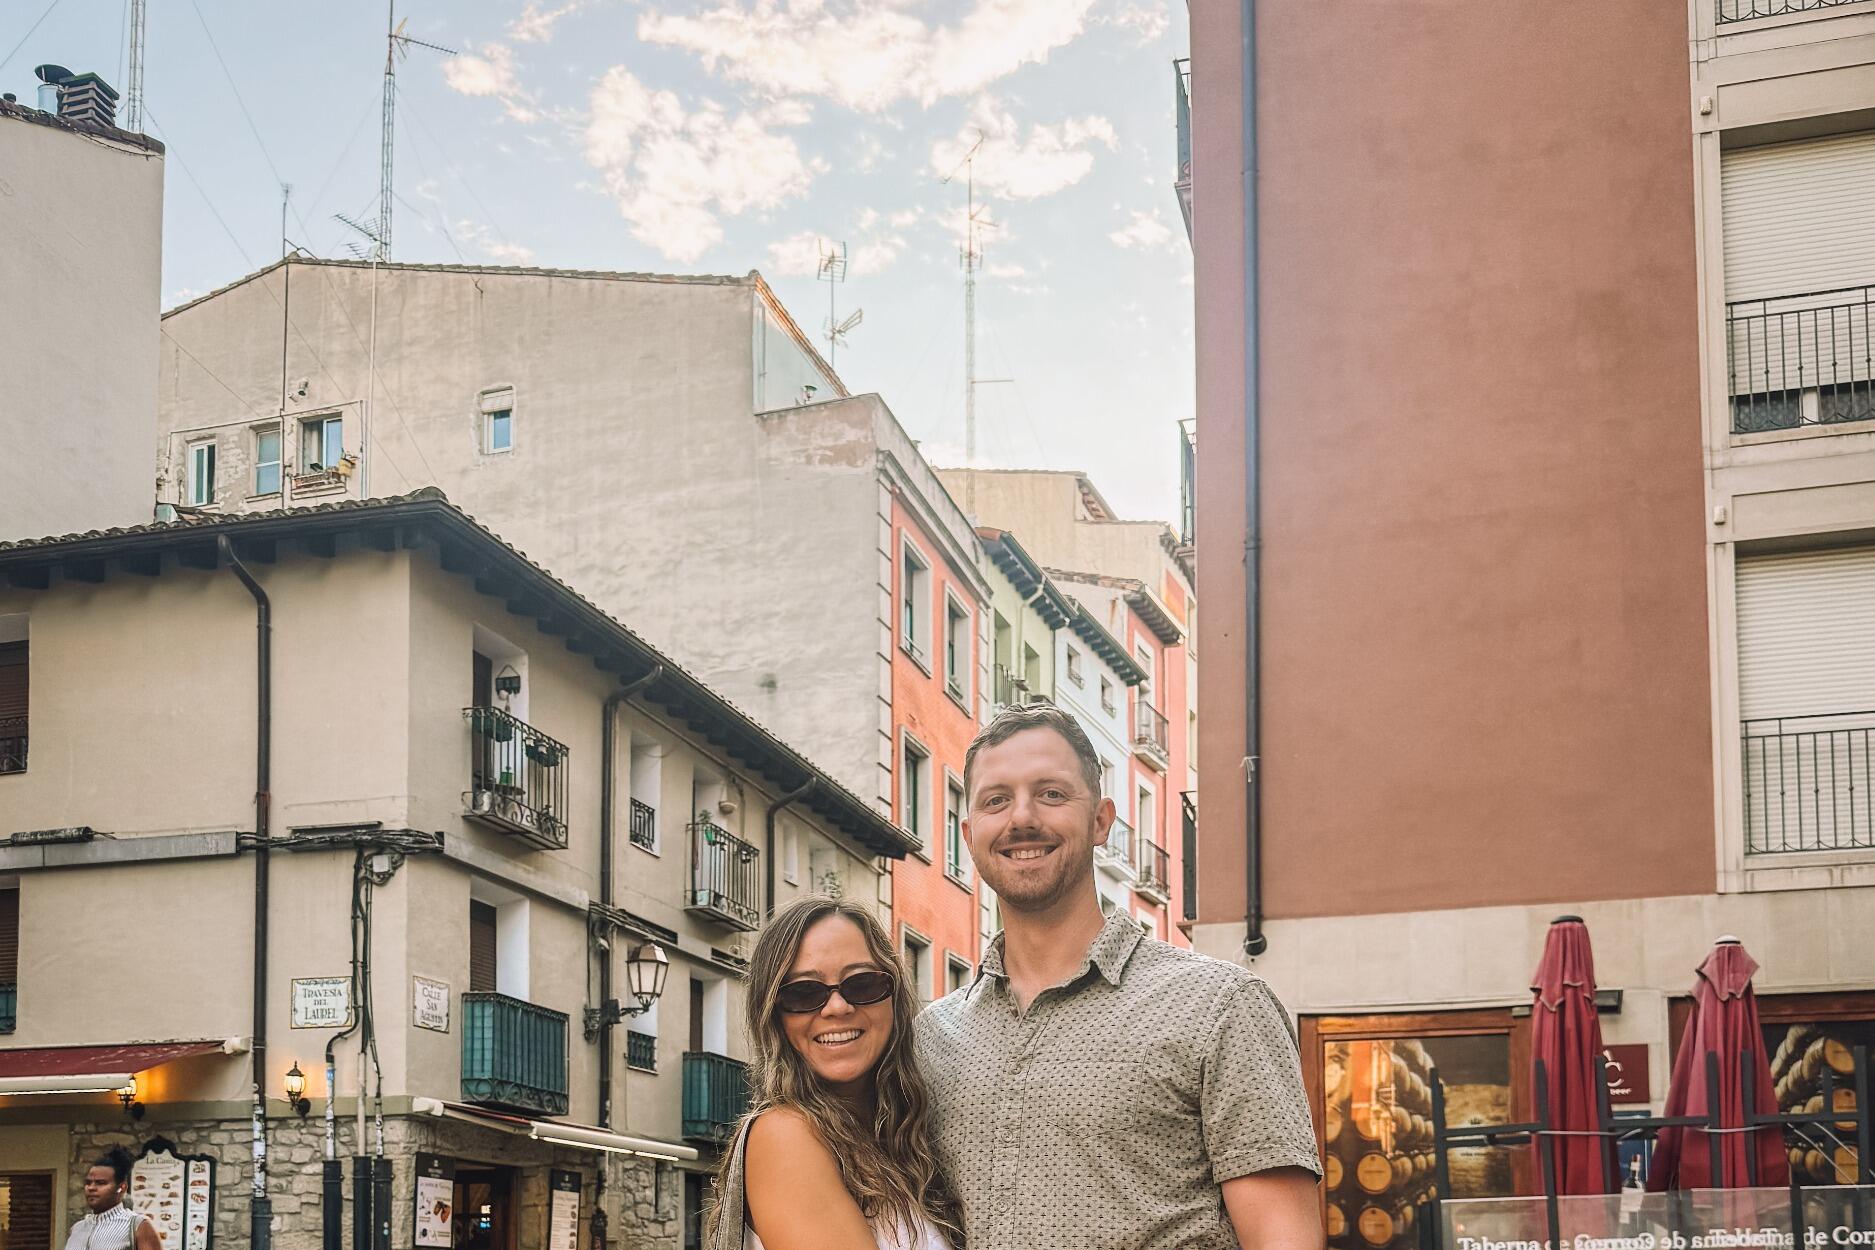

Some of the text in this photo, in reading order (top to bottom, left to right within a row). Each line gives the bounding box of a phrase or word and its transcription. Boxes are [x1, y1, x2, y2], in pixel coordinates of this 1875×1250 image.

[313, 998, 329, 1006] DEL
[304, 1006, 338, 1020] LAUREL
[1804, 1225, 1829, 1245] de
